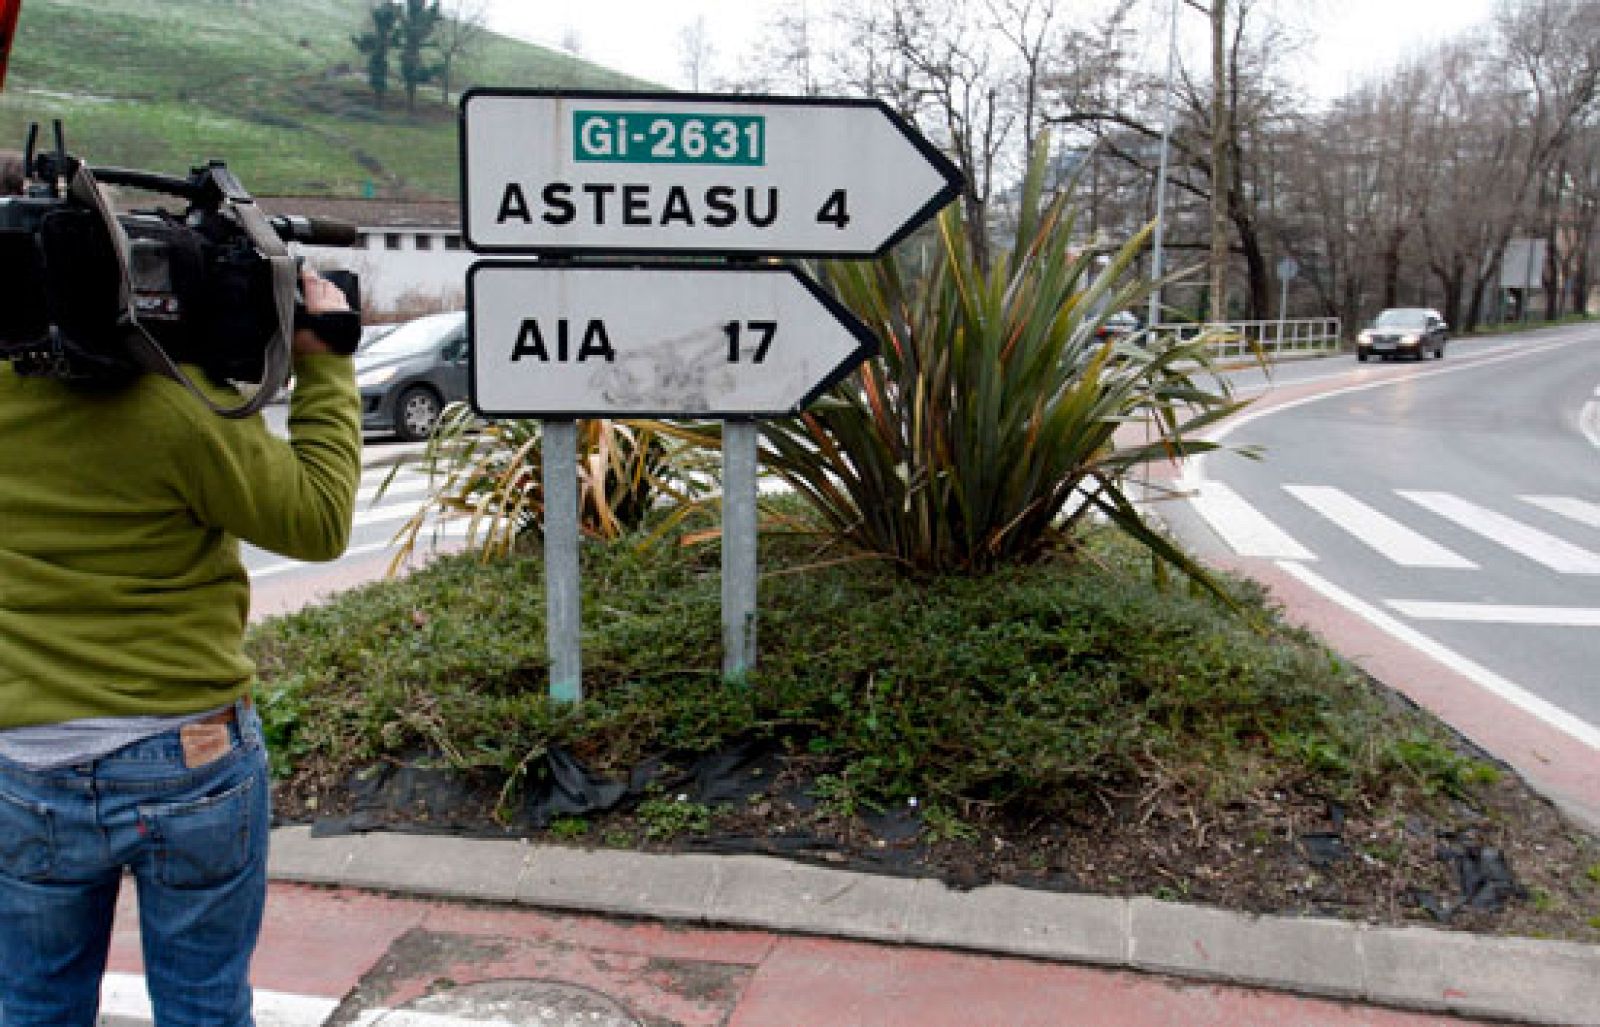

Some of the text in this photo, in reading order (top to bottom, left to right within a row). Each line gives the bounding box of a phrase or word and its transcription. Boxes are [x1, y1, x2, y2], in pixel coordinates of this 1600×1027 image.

[580, 116, 761, 160] Gi-2631
[496, 182, 851, 230] ASTEASU 4
[510, 318, 778, 364] AIA 17
